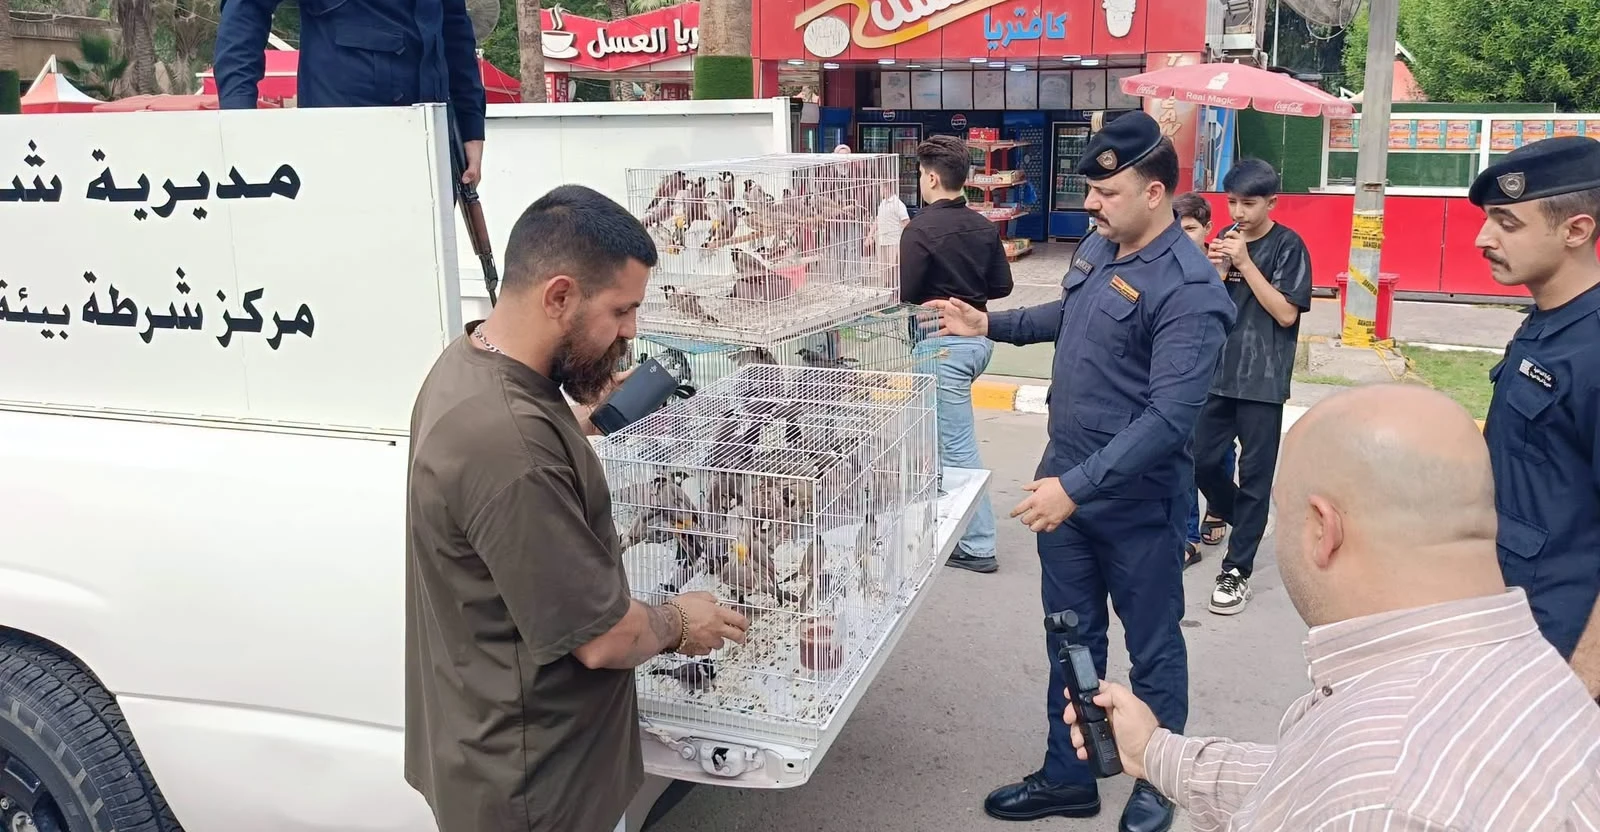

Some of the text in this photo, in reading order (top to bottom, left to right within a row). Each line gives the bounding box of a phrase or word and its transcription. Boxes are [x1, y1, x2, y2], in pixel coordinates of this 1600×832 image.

[587, 27, 667, 59] العسل
[983, 8, 1067, 49] كافتريا
[1186, 91, 1235, 106] Real Magic
[86, 147, 302, 221] مديرية
[82, 266, 204, 344] شرطة
[215, 286, 316, 350] مركز
